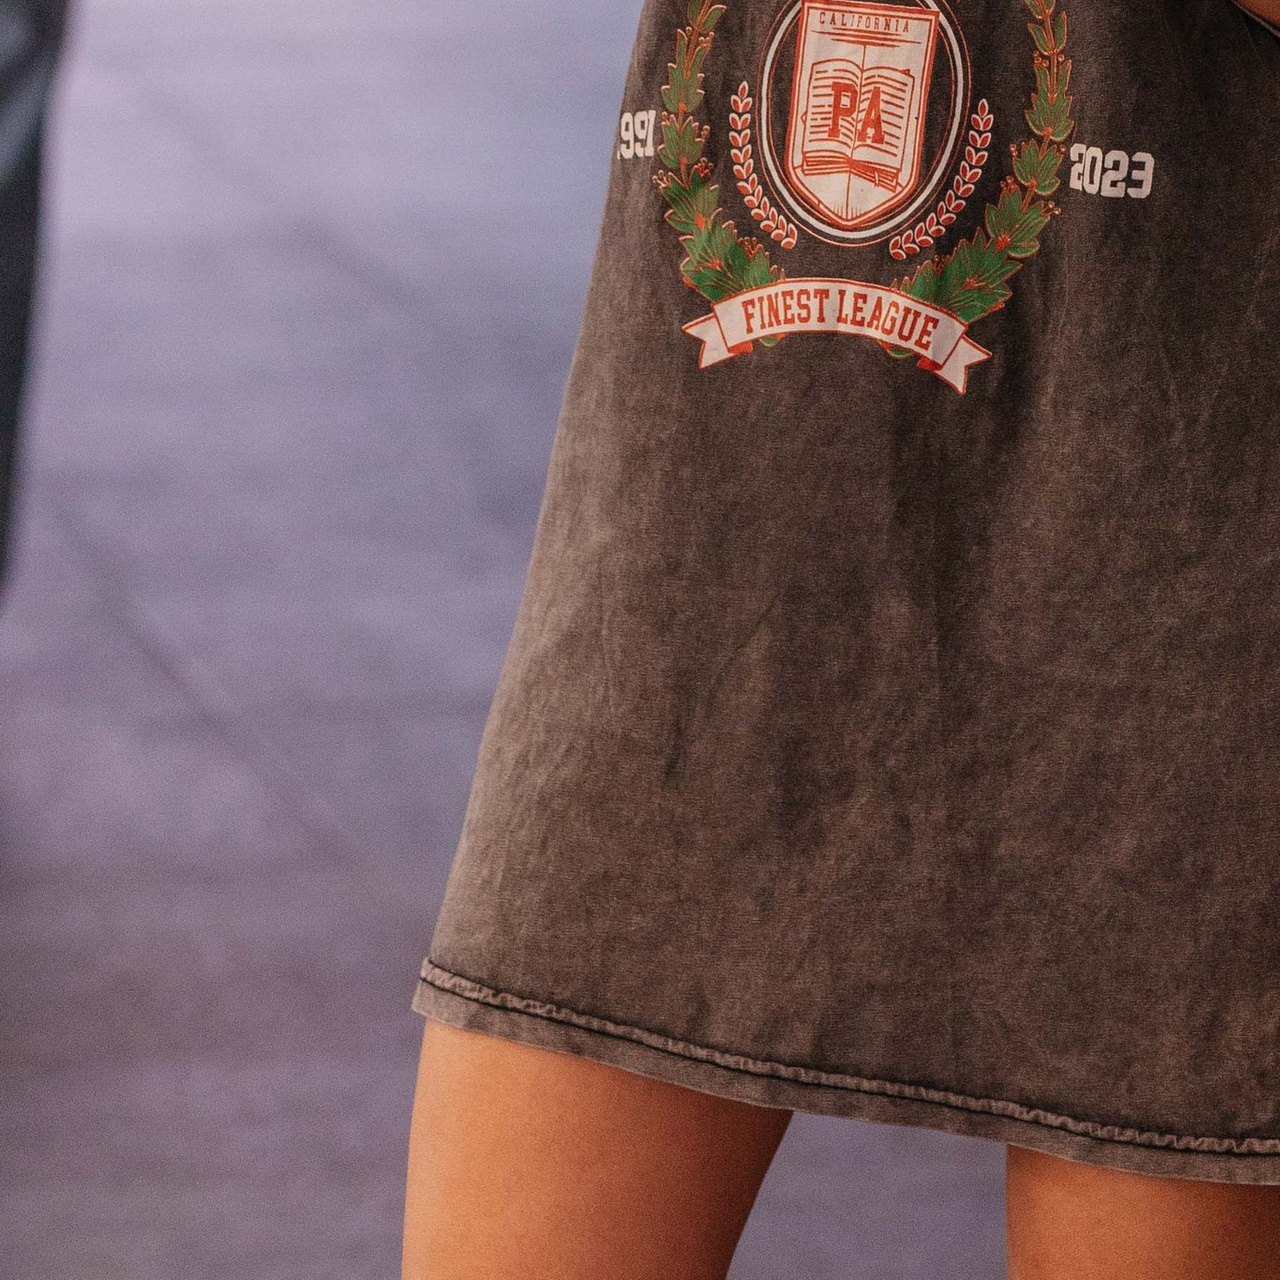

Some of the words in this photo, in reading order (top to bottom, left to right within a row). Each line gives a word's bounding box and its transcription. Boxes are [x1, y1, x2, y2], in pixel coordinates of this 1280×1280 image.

[819, 11, 910, 33] CALIFORNIA
[617, 109, 657, 160] 991
[827, 81, 885, 144] PA
[1069, 142, 1155, 199] 2023
[741, 288, 830, 335] FINEST
[836, 289, 940, 351] LEAGUE
